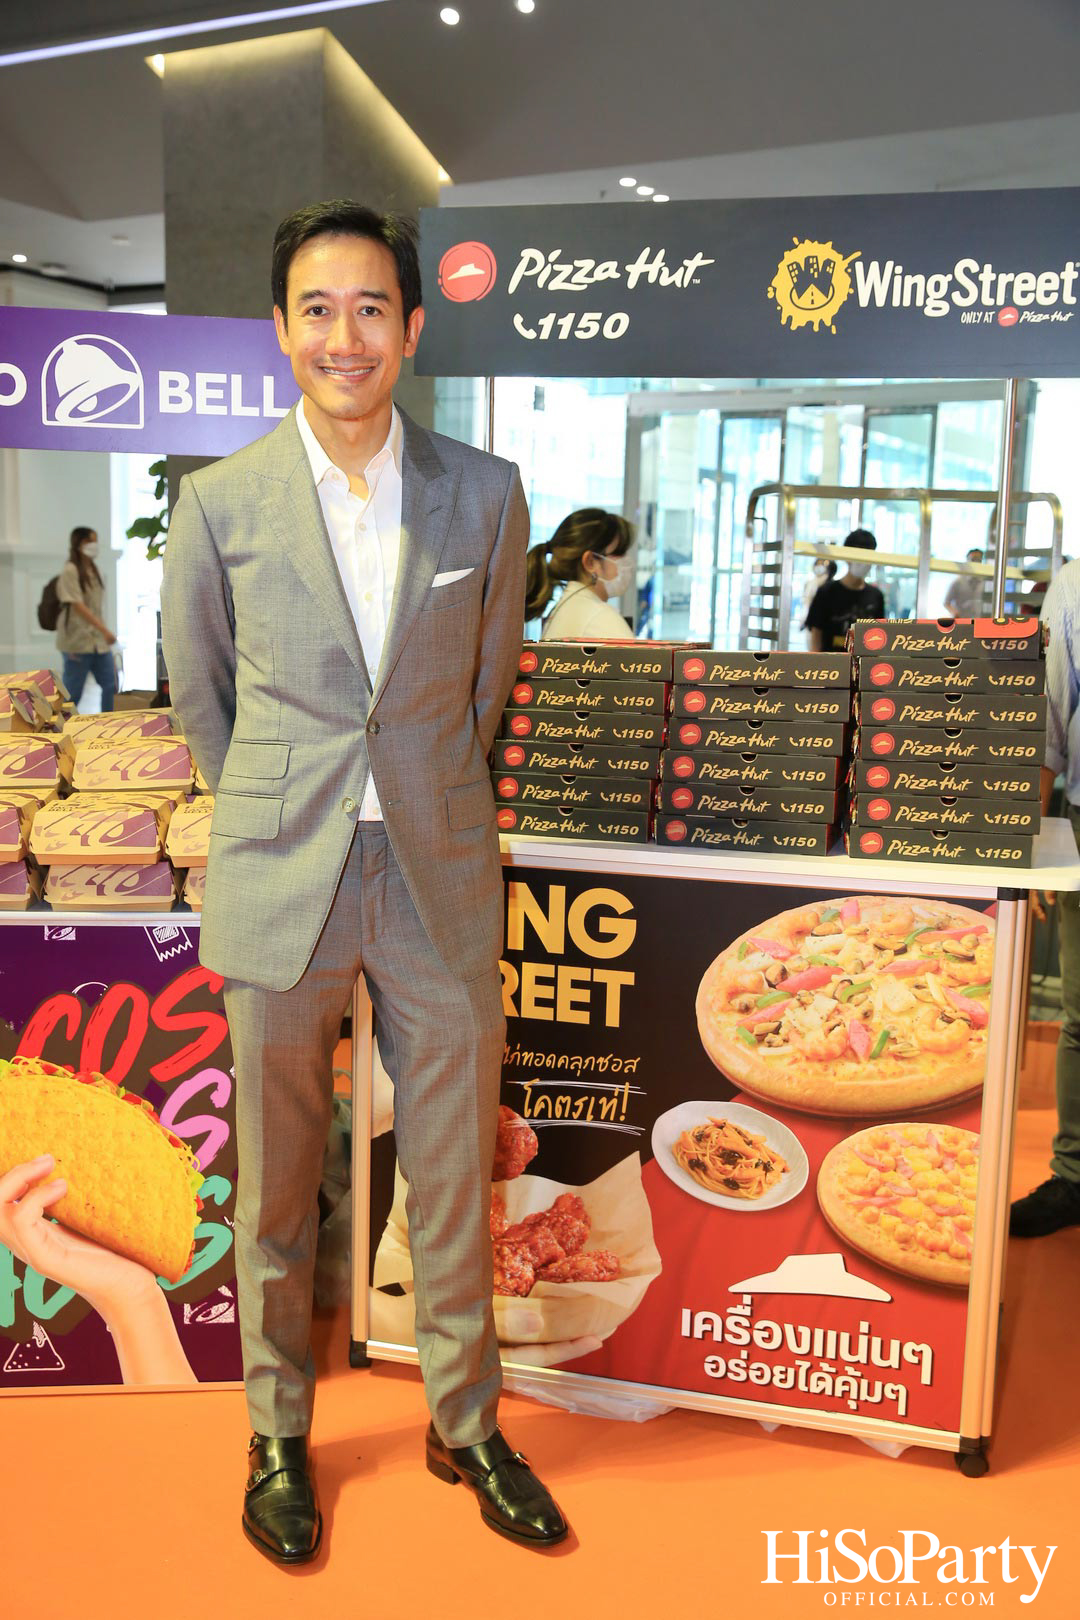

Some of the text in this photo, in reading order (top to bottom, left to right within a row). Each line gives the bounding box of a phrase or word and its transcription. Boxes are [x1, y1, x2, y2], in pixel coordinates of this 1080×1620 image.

[508, 246, 715, 294] Pizza Hut
[855, 258, 1079, 318] WingStreet
[538, 312, 630, 340] 1150
[961, 311, 996, 324] ONLY AT
[1019, 310, 1074, 324] Pizza Hut
[159, 370, 291, 418] BELL
[890, 634, 1029, 652] Pizza Hut 1150
[542, 658, 662, 674] Pizza Hut 1150
[709, 664, 840, 682] Pizza Hut 1150
[898, 670, 1036, 687] Pizza Hut 1150
[537, 690, 654, 707] Pizza Hut 1150
[710, 697, 840, 715] Pizza Hut 1150
[899, 705, 1037, 723] Pizza Hut 1150
[535, 722, 654, 739] Pizza Hut 1150
[705, 730, 834, 748] Pizza Hut 1150
[899, 740, 1037, 758] Pizza Hut 1150
[528, 753, 649, 771] Pizza Hut 1150
[700, 763, 826, 782] Pizza Hut 1150
[894, 773, 1031, 793] Pizza Hut 1150
[522, 784, 642, 804] Pizza Hut 1150
[697, 795, 825, 814] Pizza Hut 1150
[520, 815, 640, 835] Pizza Hut 1150
[895, 806, 1032, 826] Pizza Hut 1150
[690, 828, 817, 848] Pizza Hut 1150
[886, 839, 1023, 860] Pizza Hut 1150
[523, 1078, 630, 1123] โคตรเท่!
[681, 1294, 934, 1386] เครื่องแน่นๆ
[703, 1350, 908, 1416] อร่อยได้คุ้มๆ
